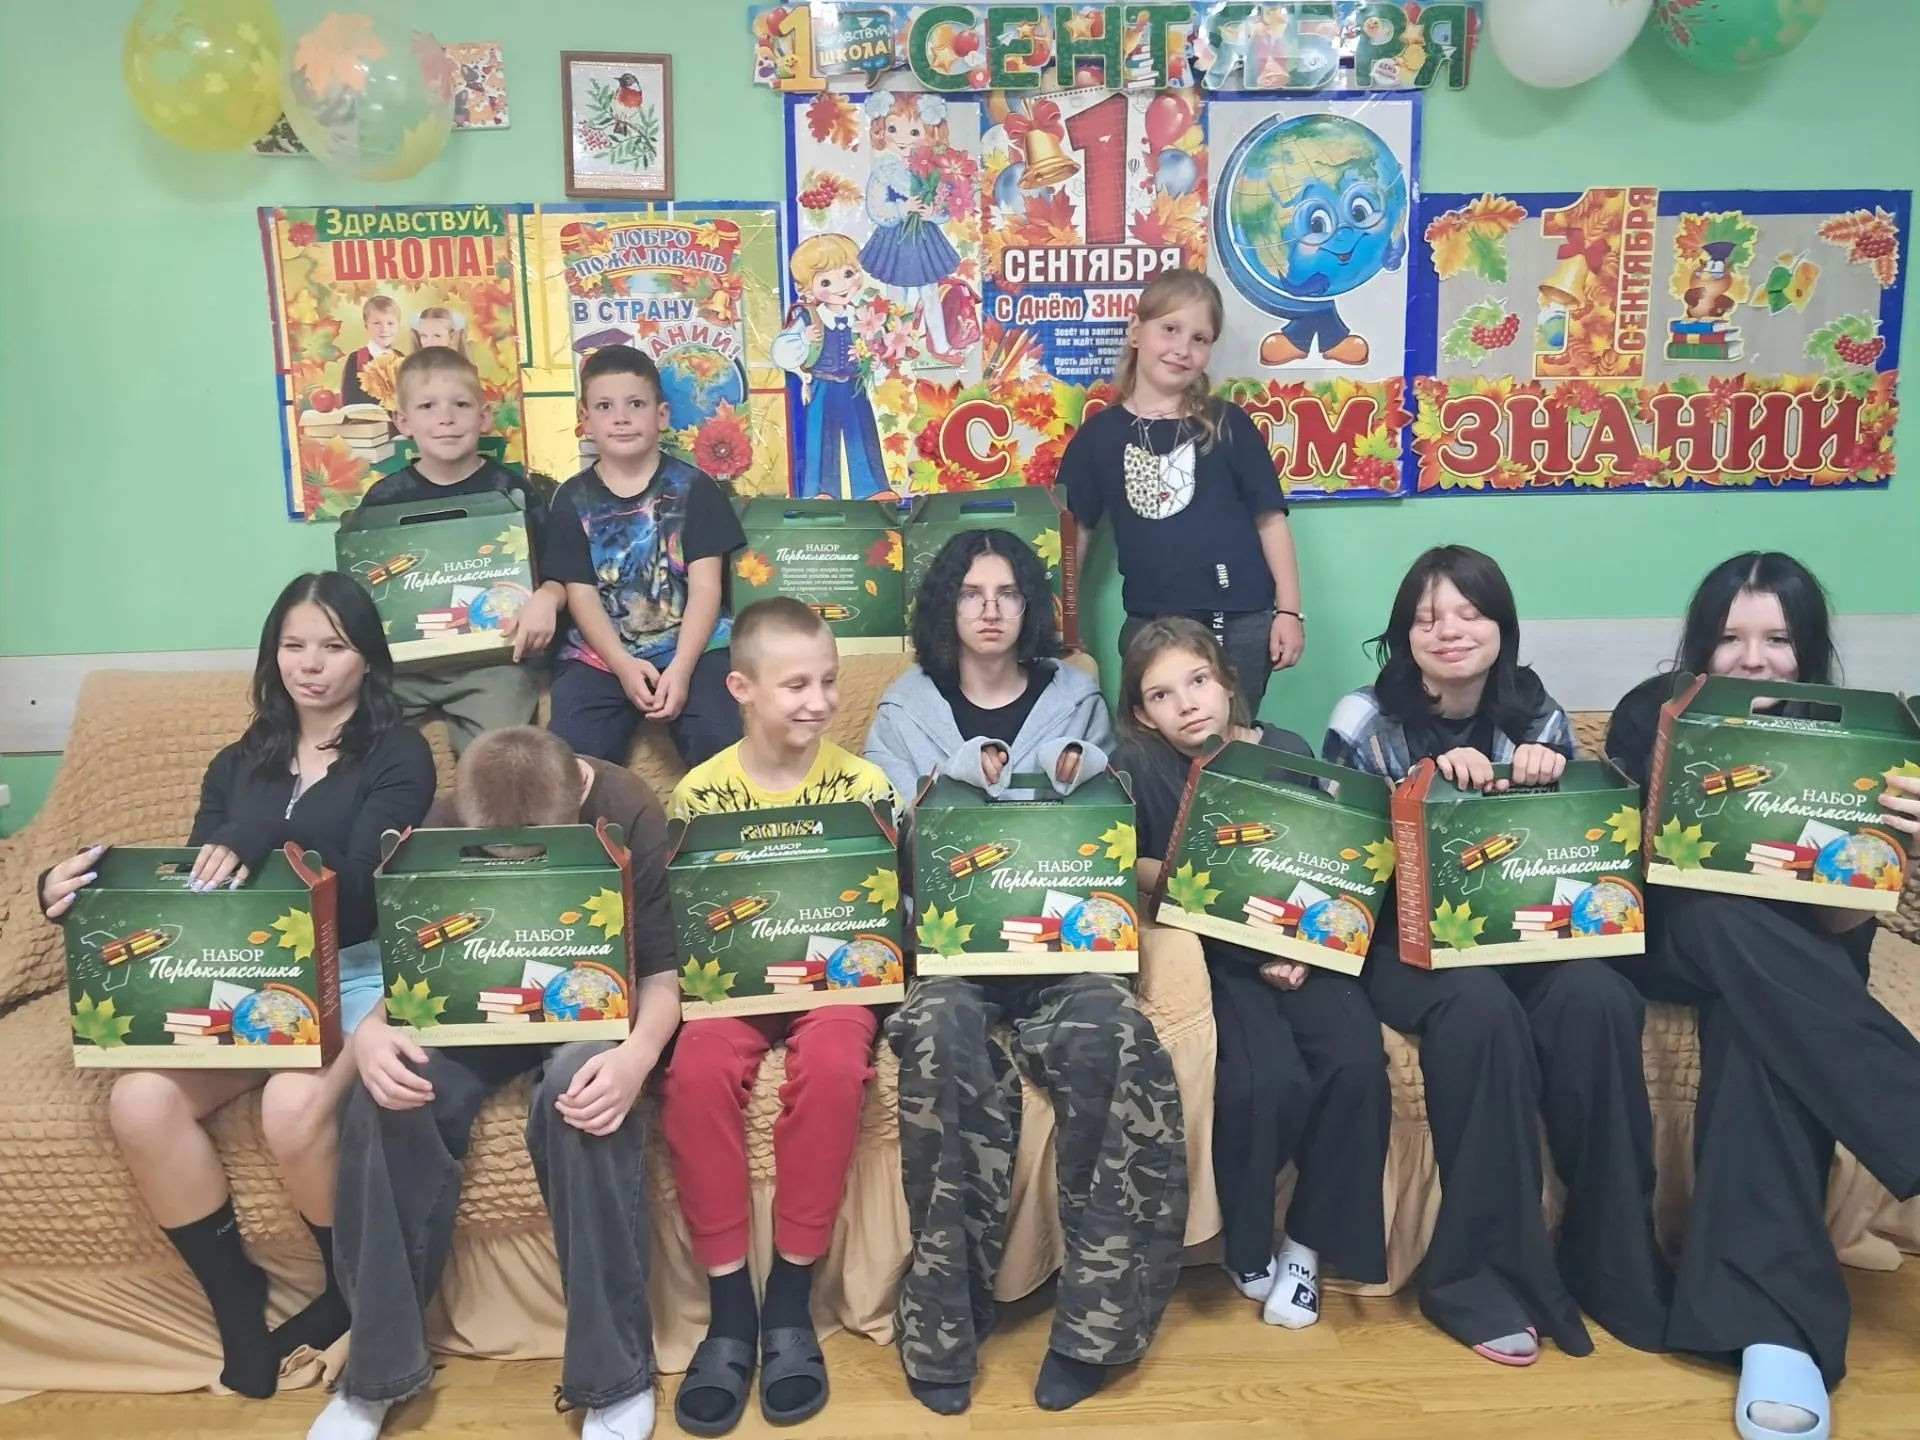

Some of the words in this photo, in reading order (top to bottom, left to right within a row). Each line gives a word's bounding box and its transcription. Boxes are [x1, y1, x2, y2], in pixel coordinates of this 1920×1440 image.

[778, 5, 829, 91] 1
[907, 4, 1467, 91] СЕНТЯБРЯ
[1065, 92, 1129, 244] 1
[612, 229, 691, 250] ДОБРО
[332, 236, 496, 281] ШКОЛА!
[575, 249, 727, 277] ПОЖАЛОВАТЬ
[1005, 247, 1181, 282] СЕНТЯБРЯ
[1618, 187, 1658, 351] СЕНТЯБРЯ
[574, 302, 589, 322] В
[598, 299, 695, 321] СТРАНУ
[1092, 293, 1138, 318] ЗНА
[650, 324, 742, 361] АНИЙ!
[939, 399, 1014, 484] С
[1437, 386, 1868, 477] ЗНАНИЙ
[444, 557, 492, 573] НАБОР
[403, 567, 521, 592] Первоклассника
[1744, 791, 1885, 825] Первоклассник
[1803, 788, 1867, 808] НАБОР
[1298, 852, 1350, 874] НАБОР
[1547, 845, 1600, 861] НАБОР
[1038, 860, 1093, 873] НАБОР
[1248, 848, 1377, 896] Первоклассника
[1501, 858, 1632, 884] Первоклассника
[990, 868, 1127, 893] Первоклассника
[800, 905, 855, 921] НАБОР
[515, 929, 576, 943] НАБОР
[751, 917, 890, 942] Первоклассника
[202, 949, 264, 962] НАБОР
[463, 938, 613, 964] Первоклассника
[149, 956, 304, 983] Первоклассника
